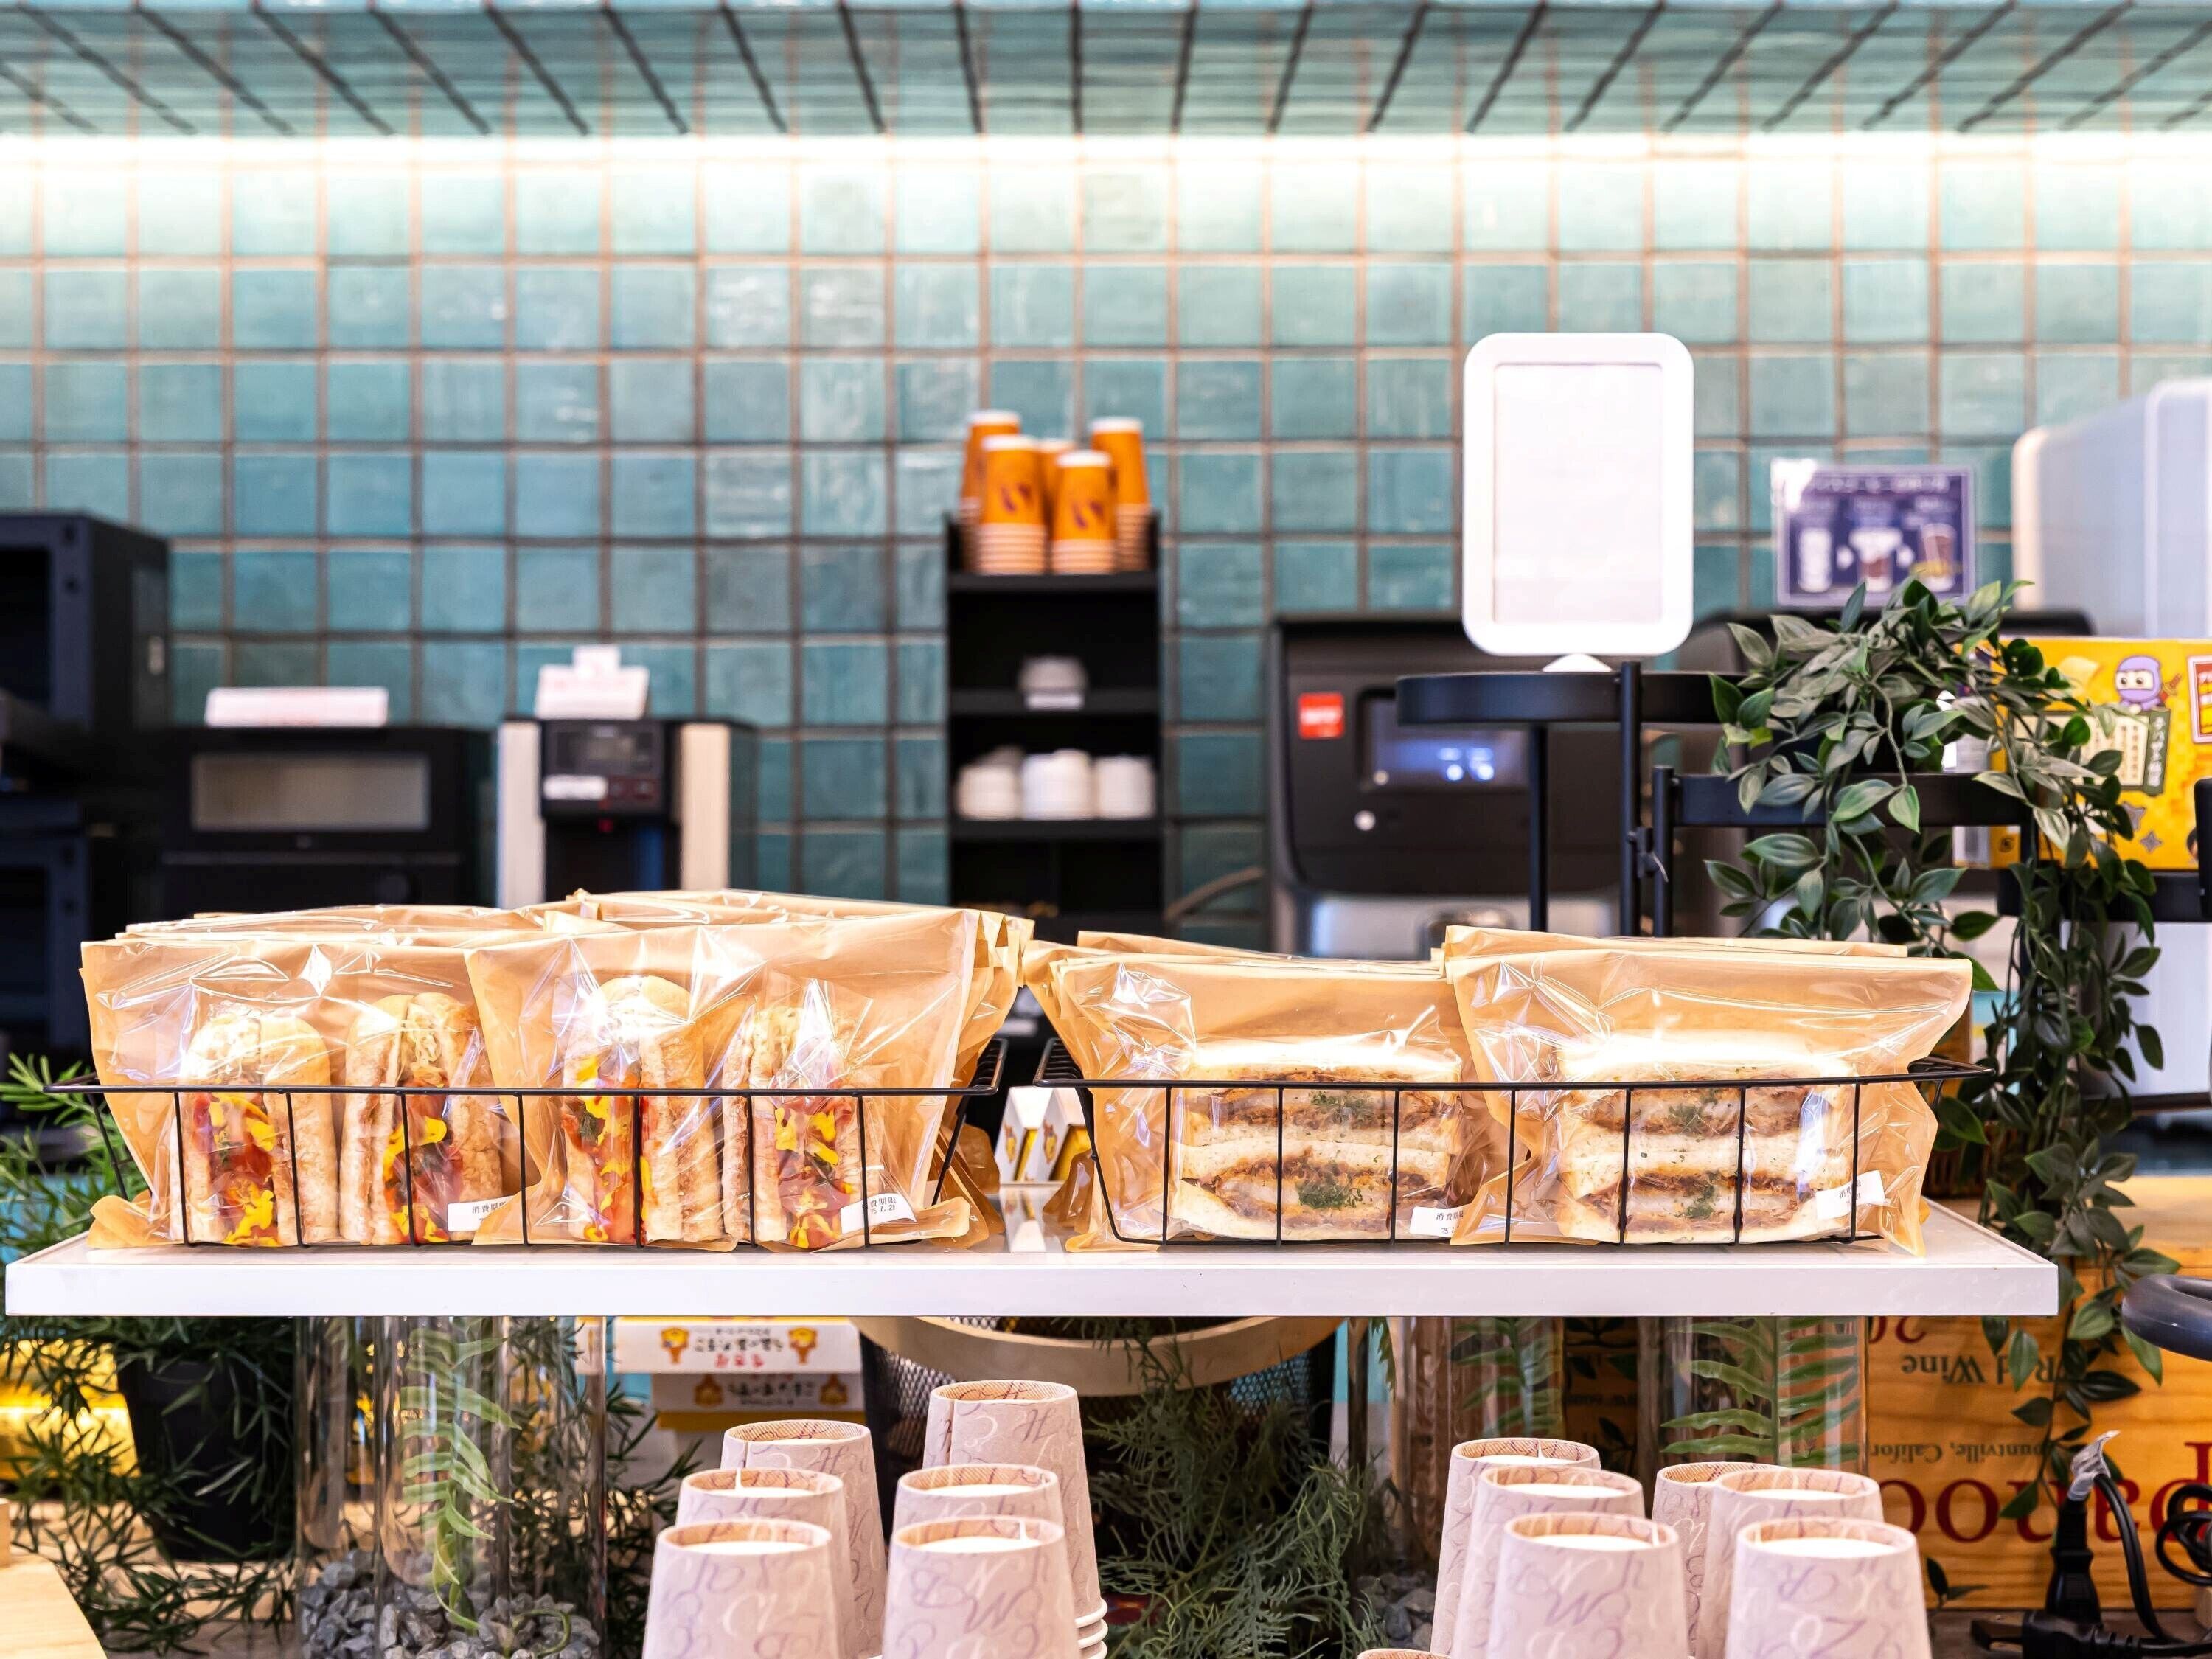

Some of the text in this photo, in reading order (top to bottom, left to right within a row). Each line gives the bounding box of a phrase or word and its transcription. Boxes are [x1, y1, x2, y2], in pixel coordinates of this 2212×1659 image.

[1901, 1355, 2055, 1384] Rd Wine
[1950, 1442, 2045, 1464] ountville,
